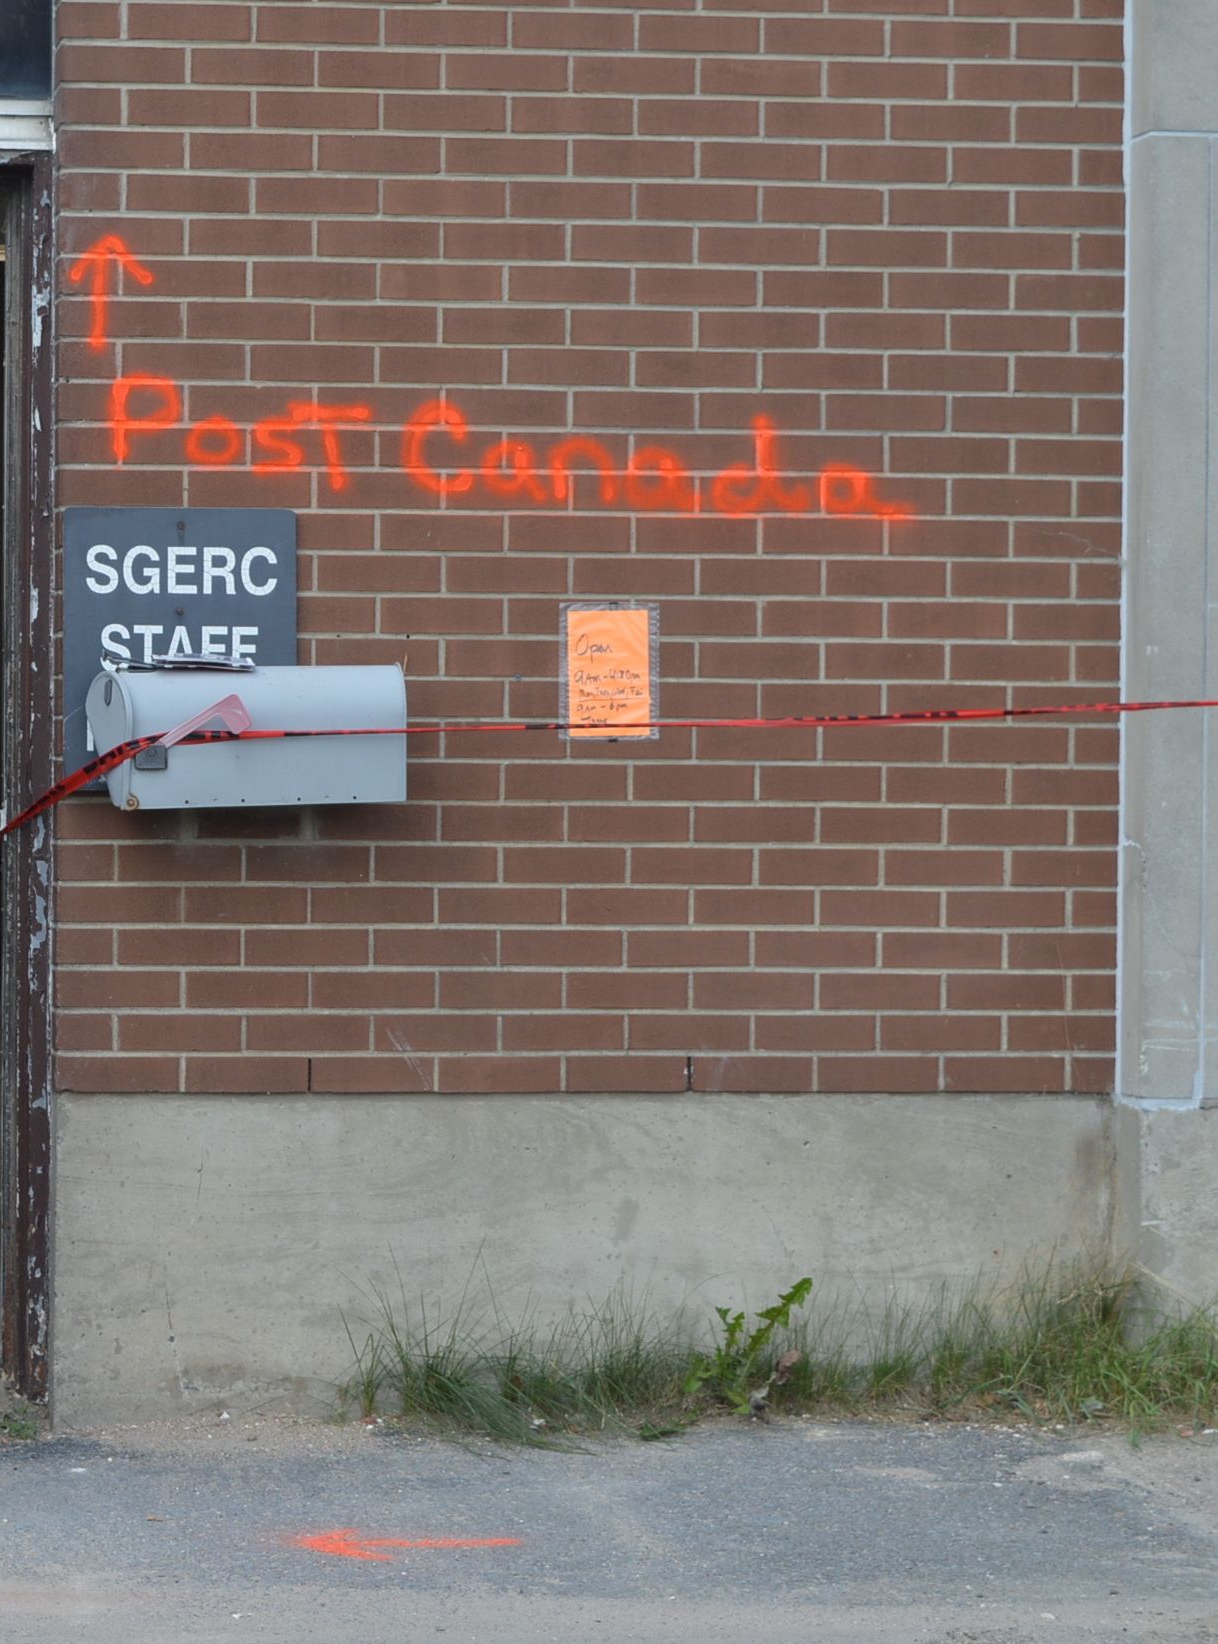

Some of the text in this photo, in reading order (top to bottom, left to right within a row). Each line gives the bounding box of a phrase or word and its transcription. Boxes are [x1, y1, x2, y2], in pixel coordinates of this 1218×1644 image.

[402, 400, 916, 520] Canada
[85, 544, 278, 596] SGERC
[575, 633, 613, 663] Open
